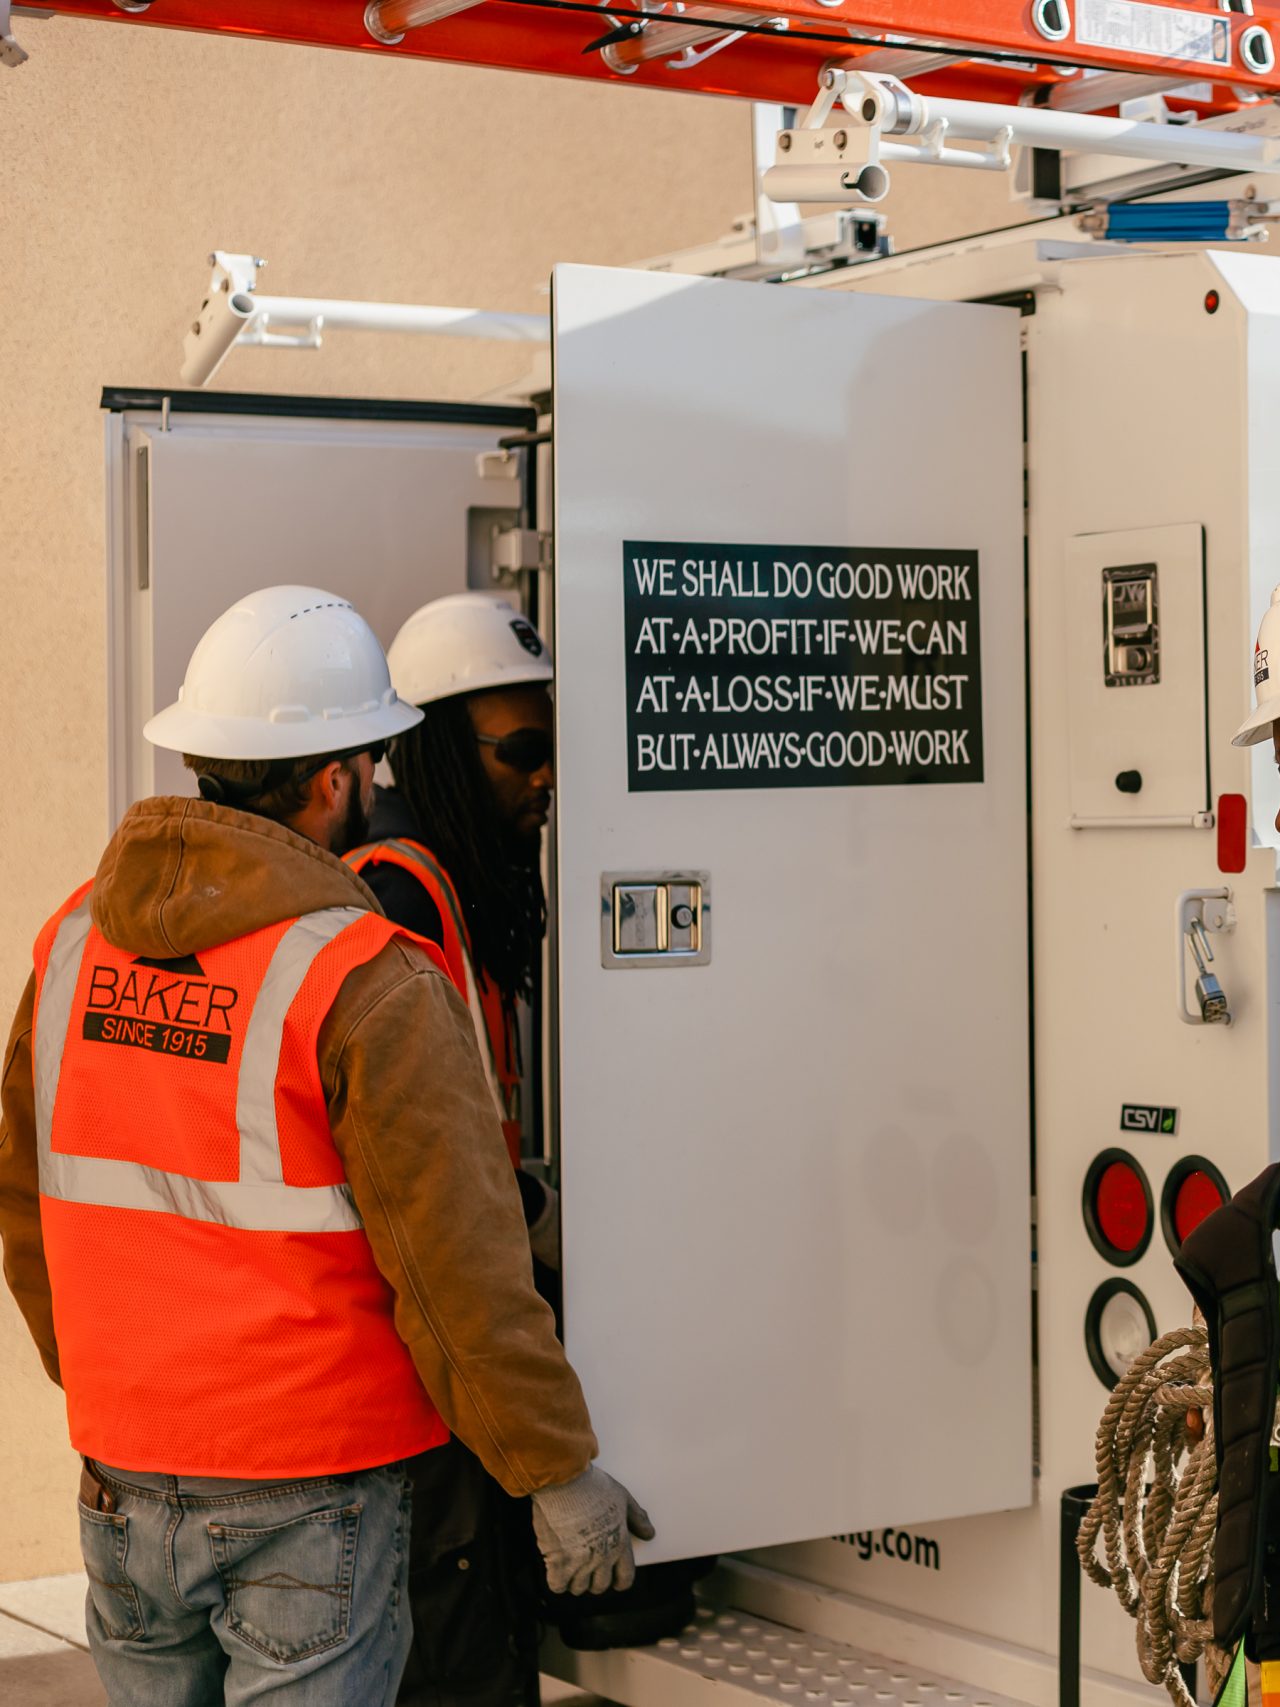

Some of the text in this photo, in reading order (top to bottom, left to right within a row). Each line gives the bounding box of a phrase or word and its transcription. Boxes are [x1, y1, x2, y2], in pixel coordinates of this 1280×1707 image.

[632, 558, 972, 601] WE SHALL DO GOOD WORK
[87, 965, 239, 1031] BAKER
[101, 1017, 208, 1057] SINCE 1915
[1124, 1109, 1158, 1129] CSV
